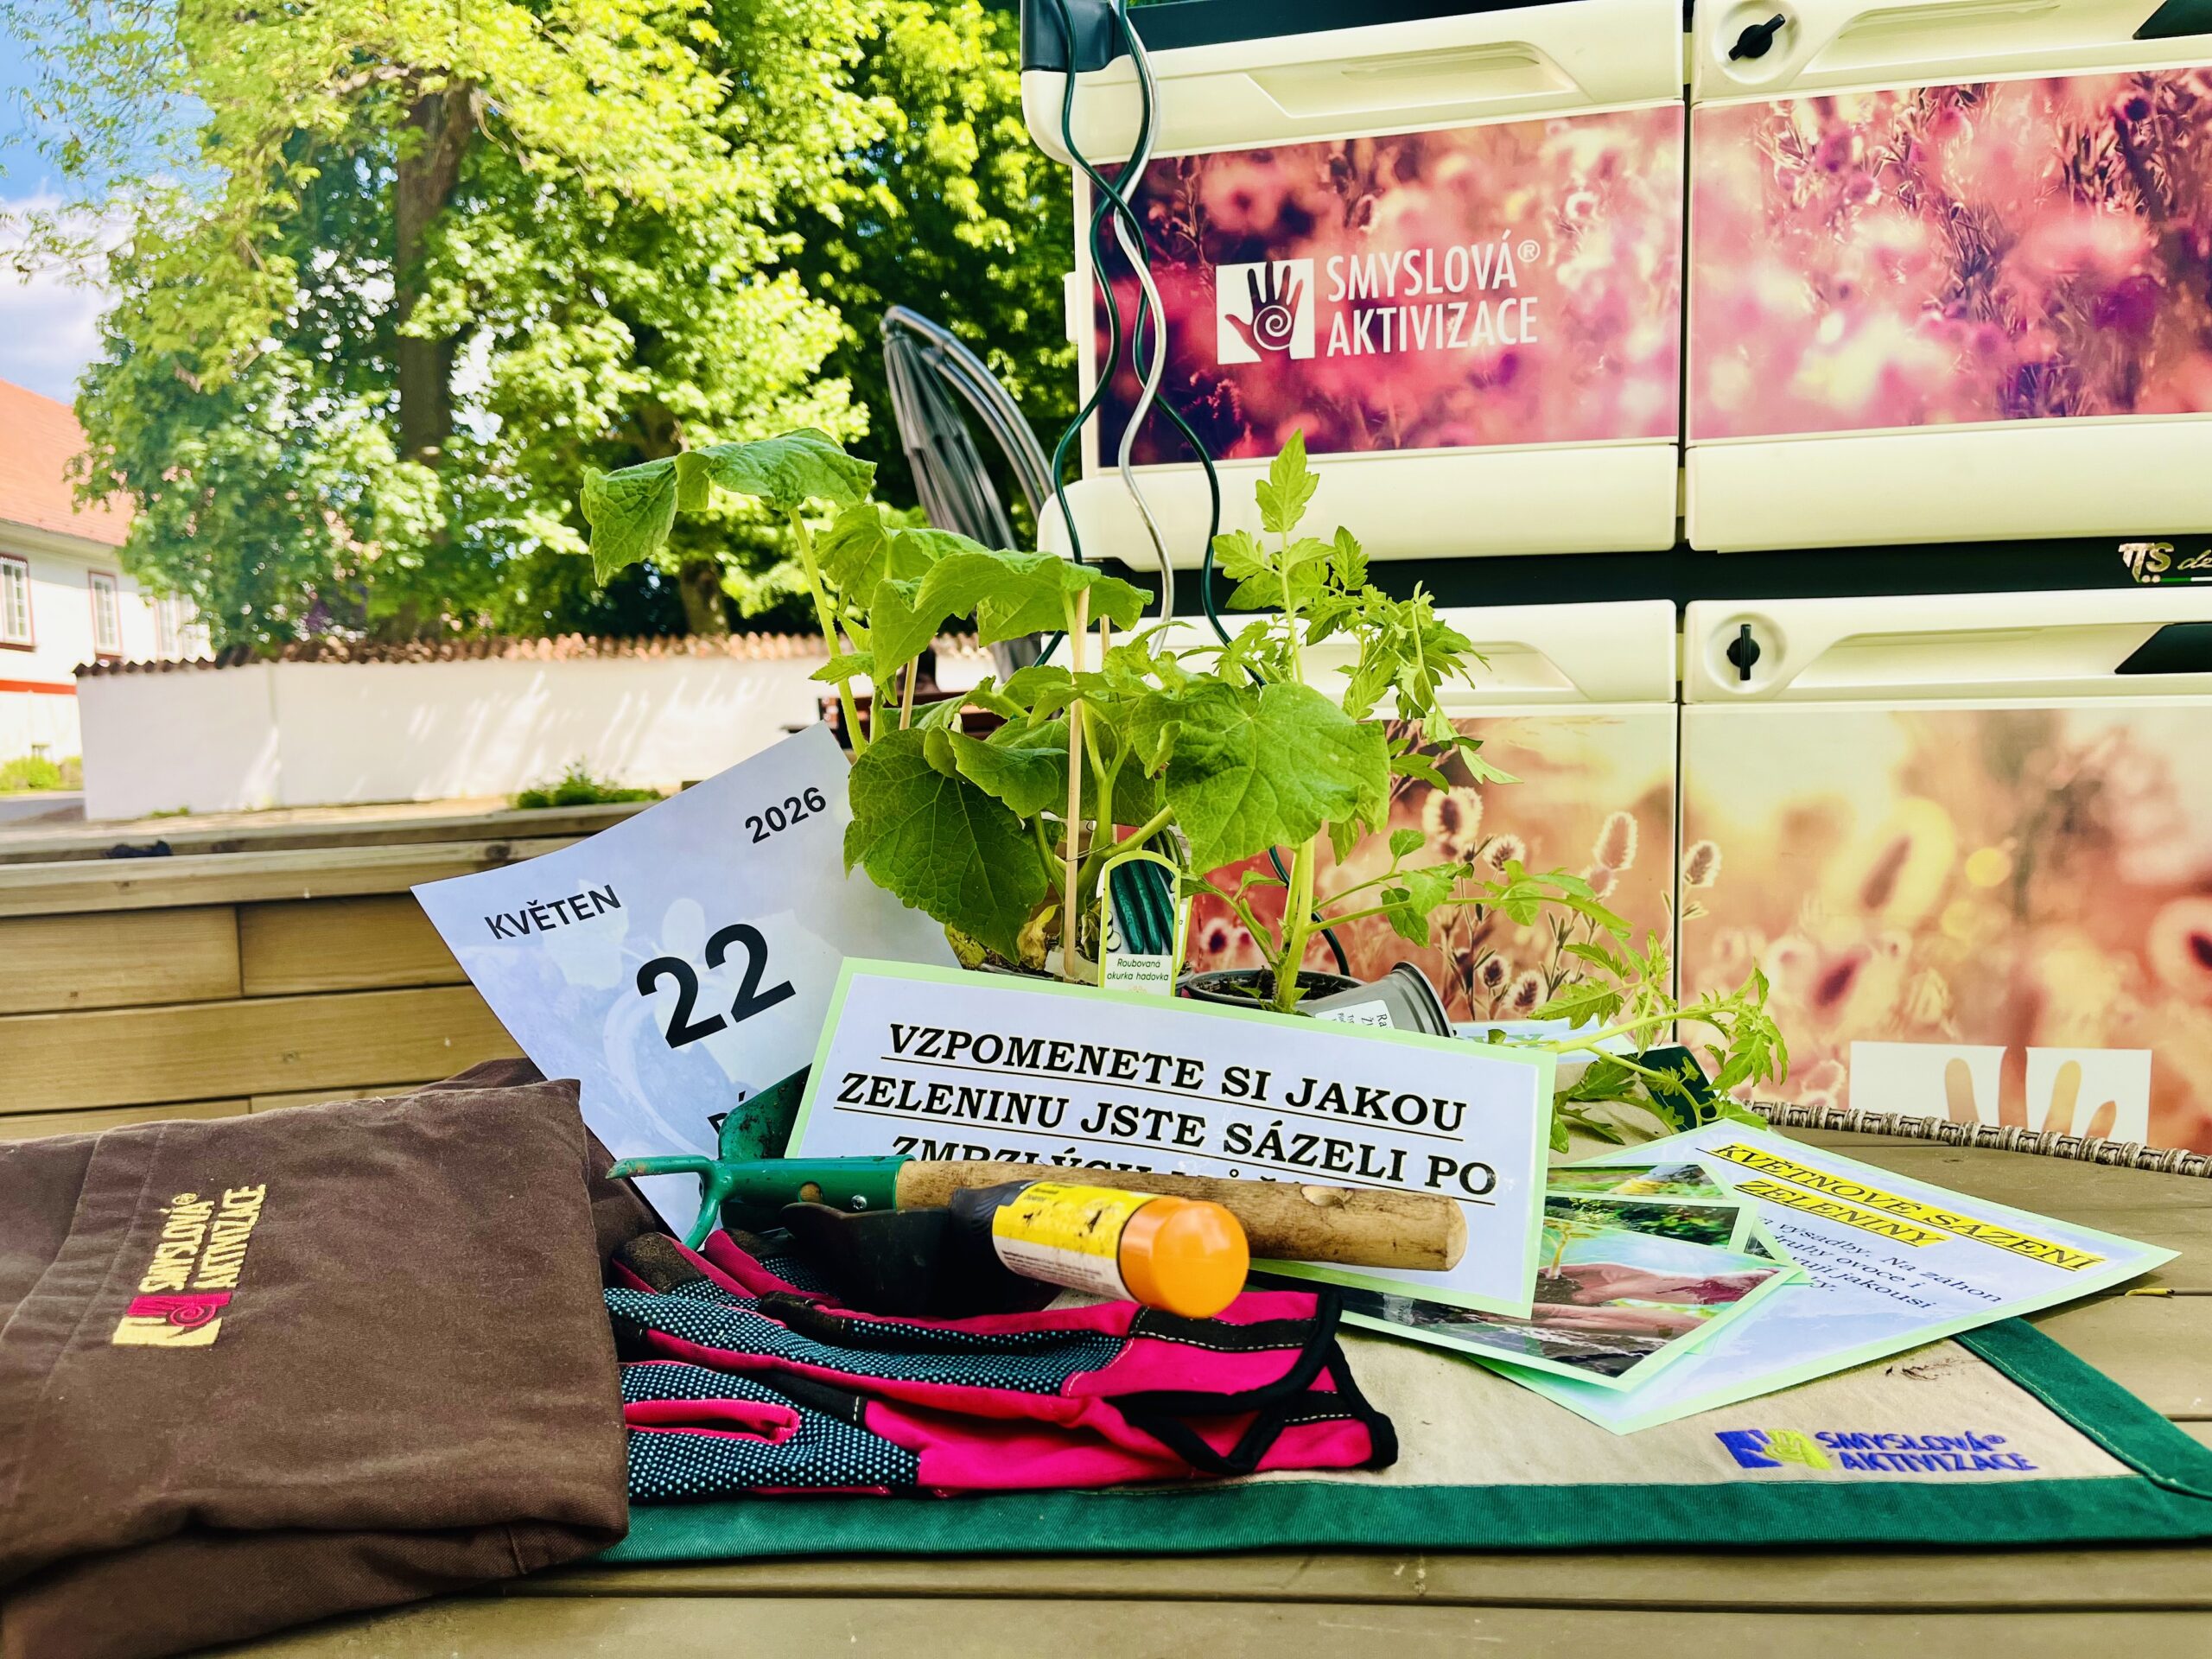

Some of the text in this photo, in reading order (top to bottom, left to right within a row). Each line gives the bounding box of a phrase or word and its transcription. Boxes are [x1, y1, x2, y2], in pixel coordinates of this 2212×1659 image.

[1326, 296, 1539, 358] AKTIVIZACE
[745, 787, 827, 843] 2026
[485, 884, 622, 940] KVĚTEN
[636, 923, 797, 1049] 22
[1107, 971, 1169, 982] okurka hadovka
[1117, 957, 1161, 968] Roubovaná
[889, 1023, 1467, 1132] VZPOMENETE SI JAKOU
[836, 1072, 1497, 1196] ZELENINU JSTE SÁZELI PO
[1712, 1144, 2107, 1270] KVĚTNOVÉ SÁZENÍ
[1734, 1179, 1945, 1243] ZELENINY
[1780, 1224, 2003, 1303] výsadby. Na záhon
[1828, 1272, 1937, 1309] jakousi
[1836, 1256, 1906, 1282] ovoce
[1838, 1452, 2040, 1472] AKTIVIZACE
